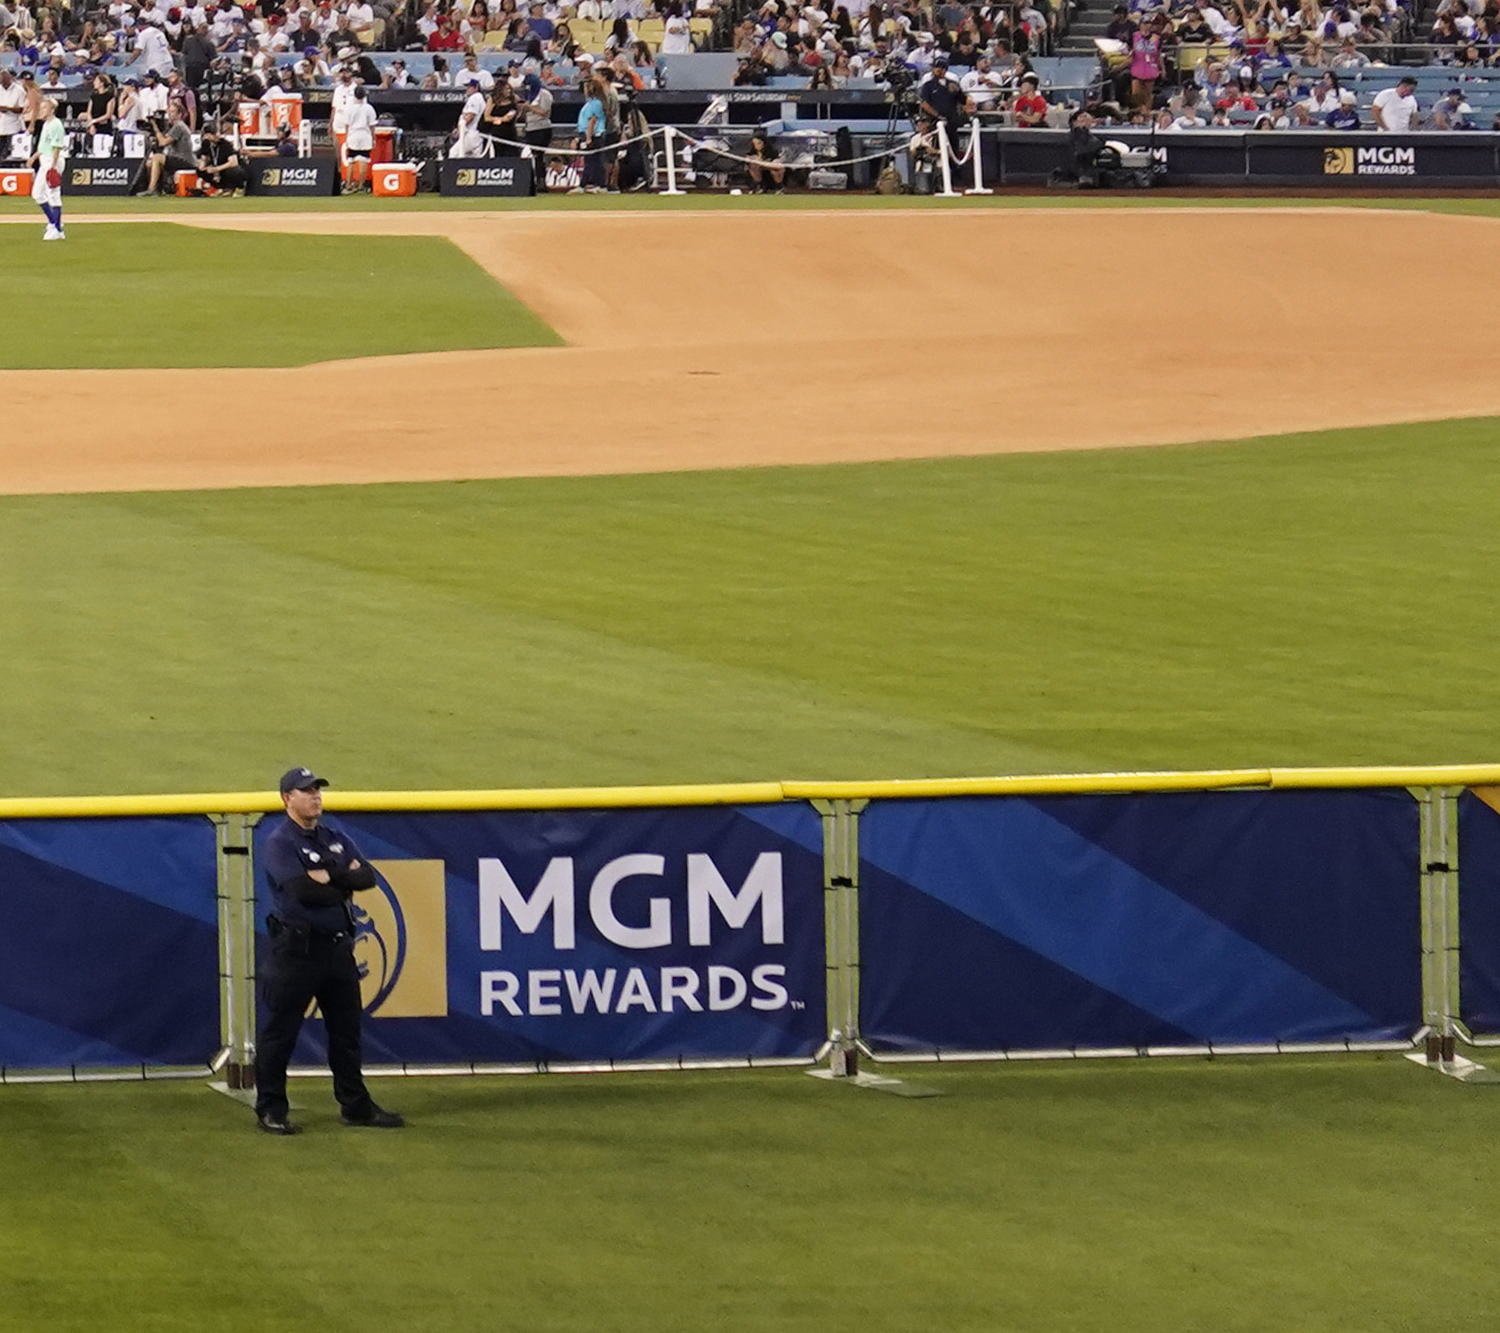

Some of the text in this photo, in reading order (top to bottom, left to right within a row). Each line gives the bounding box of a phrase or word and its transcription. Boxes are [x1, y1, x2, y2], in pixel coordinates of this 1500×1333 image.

[1357, 147, 1415, 164] MGM
[92, 168, 128, 180] MGM
[281, 168, 318, 179] MGM
[478, 168, 514, 180] MGM
[1357, 164, 1415, 175] REWARDS
[2, 176, 17, 192] G
[383, 174, 399, 191] G
[477, 852, 785, 951] MGM
[480, 964, 789, 1016] REWARDS
